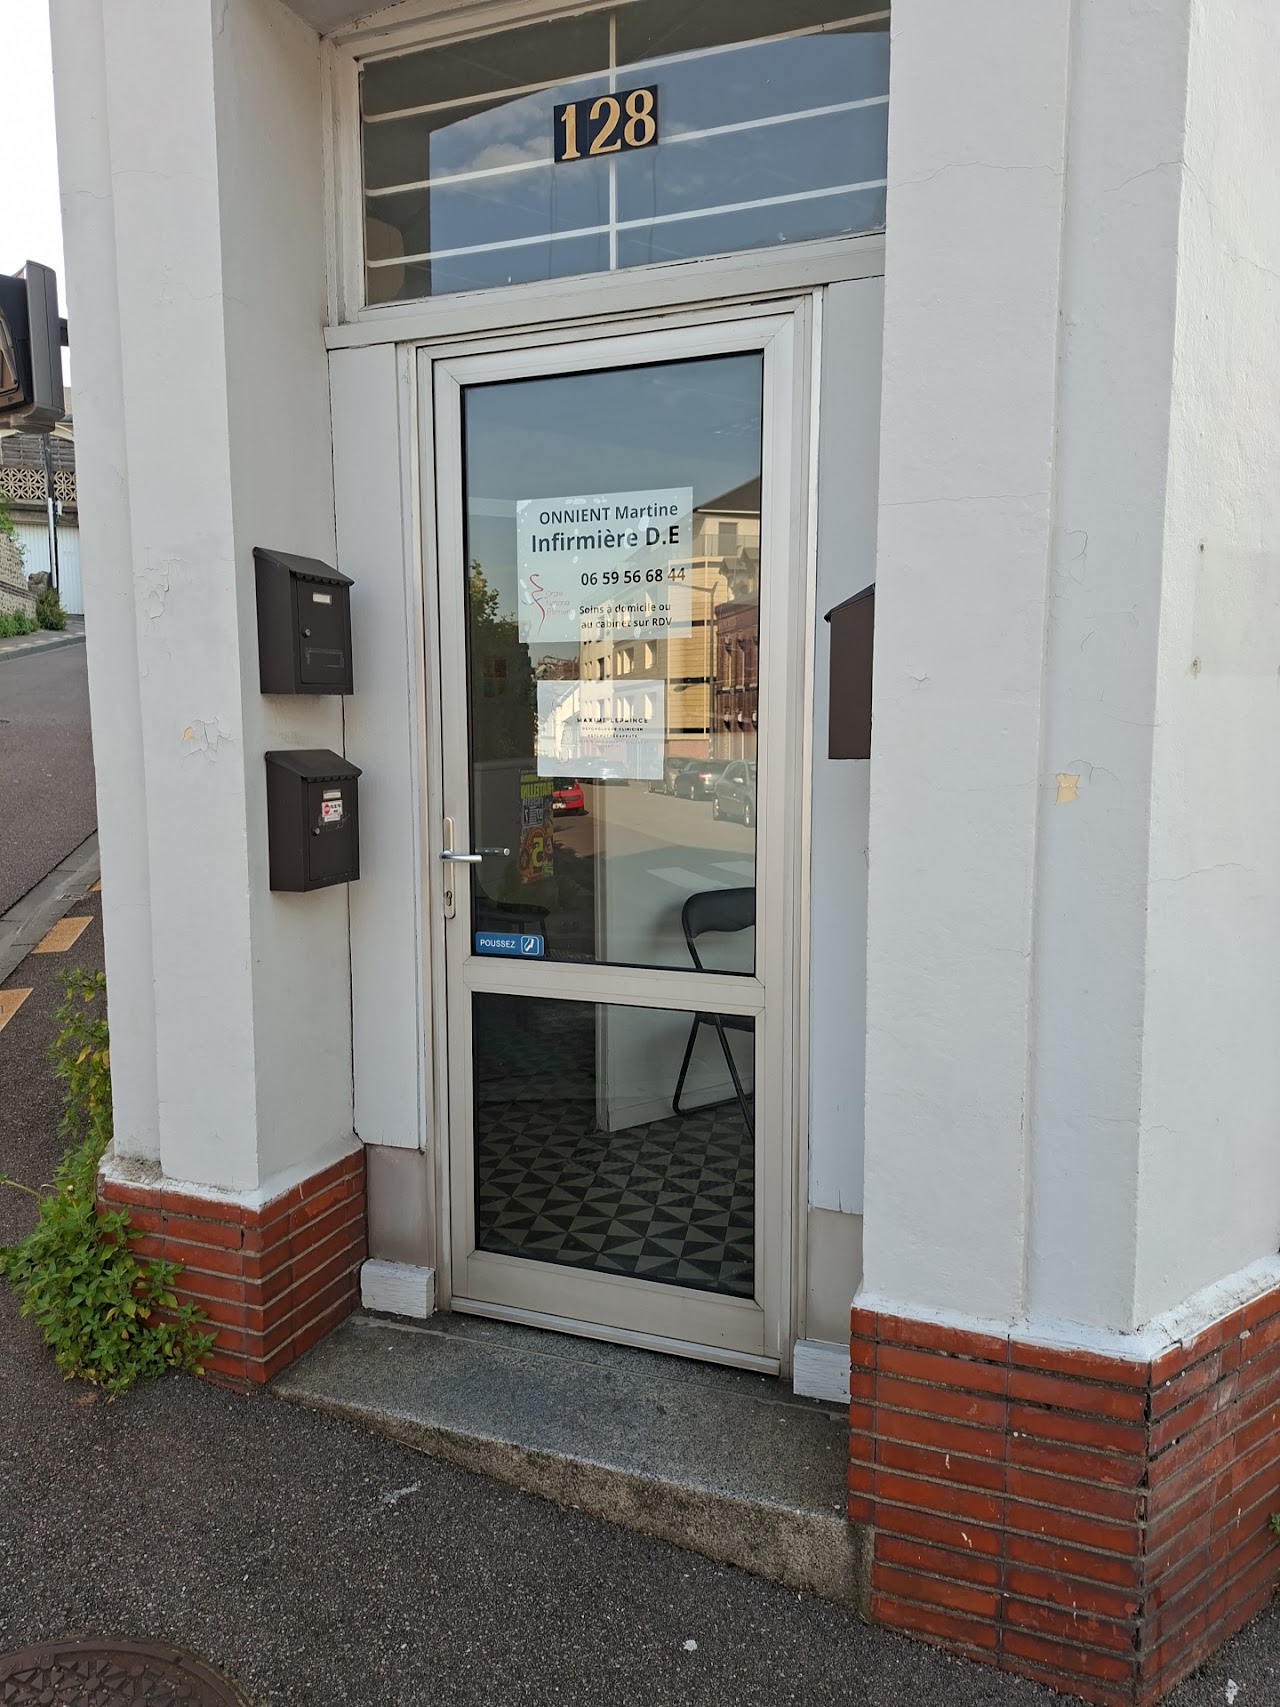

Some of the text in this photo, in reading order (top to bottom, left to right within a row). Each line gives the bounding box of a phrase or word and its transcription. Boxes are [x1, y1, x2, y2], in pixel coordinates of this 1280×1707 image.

[561, 89, 656, 160] 128
[539, 503, 678, 525] ONNIENT Martine
[532, 525, 680, 552] Infirmière D.E
[581, 567, 686, 586] 06 59 56 68 44
[579, 603, 671, 615] Soins à domicile ou
[581, 617, 672, 629] au cabinet sur RDV
[480, 939, 516, 949] POUSSEZ
